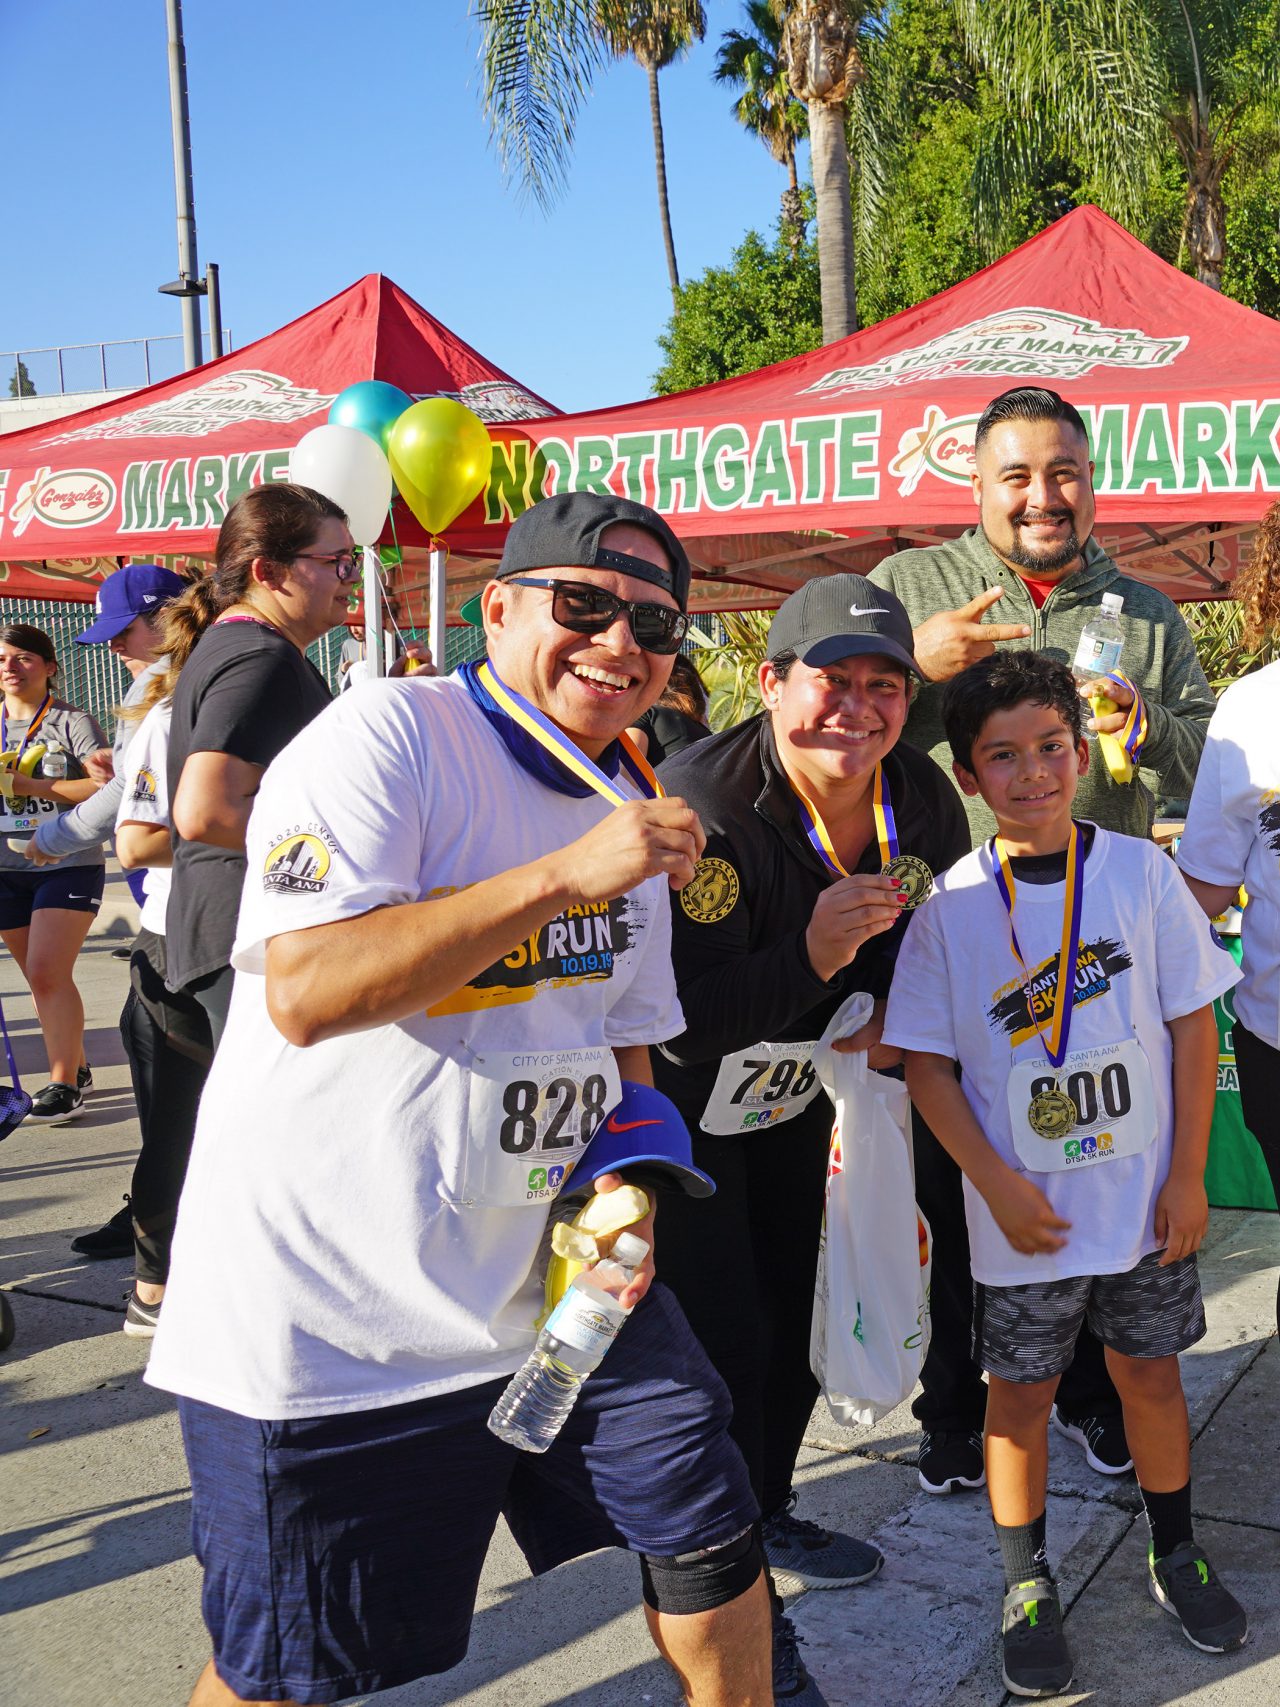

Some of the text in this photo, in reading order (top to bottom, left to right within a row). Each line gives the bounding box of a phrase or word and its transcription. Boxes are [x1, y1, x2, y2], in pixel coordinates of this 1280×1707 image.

[1020, 337, 1147, 361] MARKET
[483, 408, 882, 524] NORTHGATE
[41, 484, 104, 509] Gonzalez
[117, 447, 298, 534] MARKE
[268, 822, 340, 855] 2020 CENSUS
[292, 880, 320, 891] ANA
[547, 915, 613, 959] RUN
[561, 952, 612, 975] 10.19.19
[1024, 972, 1060, 998] SANT
[1075, 979, 1107, 1001] 10.19.19
[512, 1051, 602, 1067] CITY OF SANTA ANA
[784, 1043, 811, 1051] SANTA
[1031, 1045, 1120, 1069] CIT SANTA ANA
[729, 1059, 816, 1105] 798
[500, 1073, 607, 1154] 828
[1065, 1149, 1115, 1165] DTSA 5K RUN
[526, 1190, 550, 1200] DTSA
